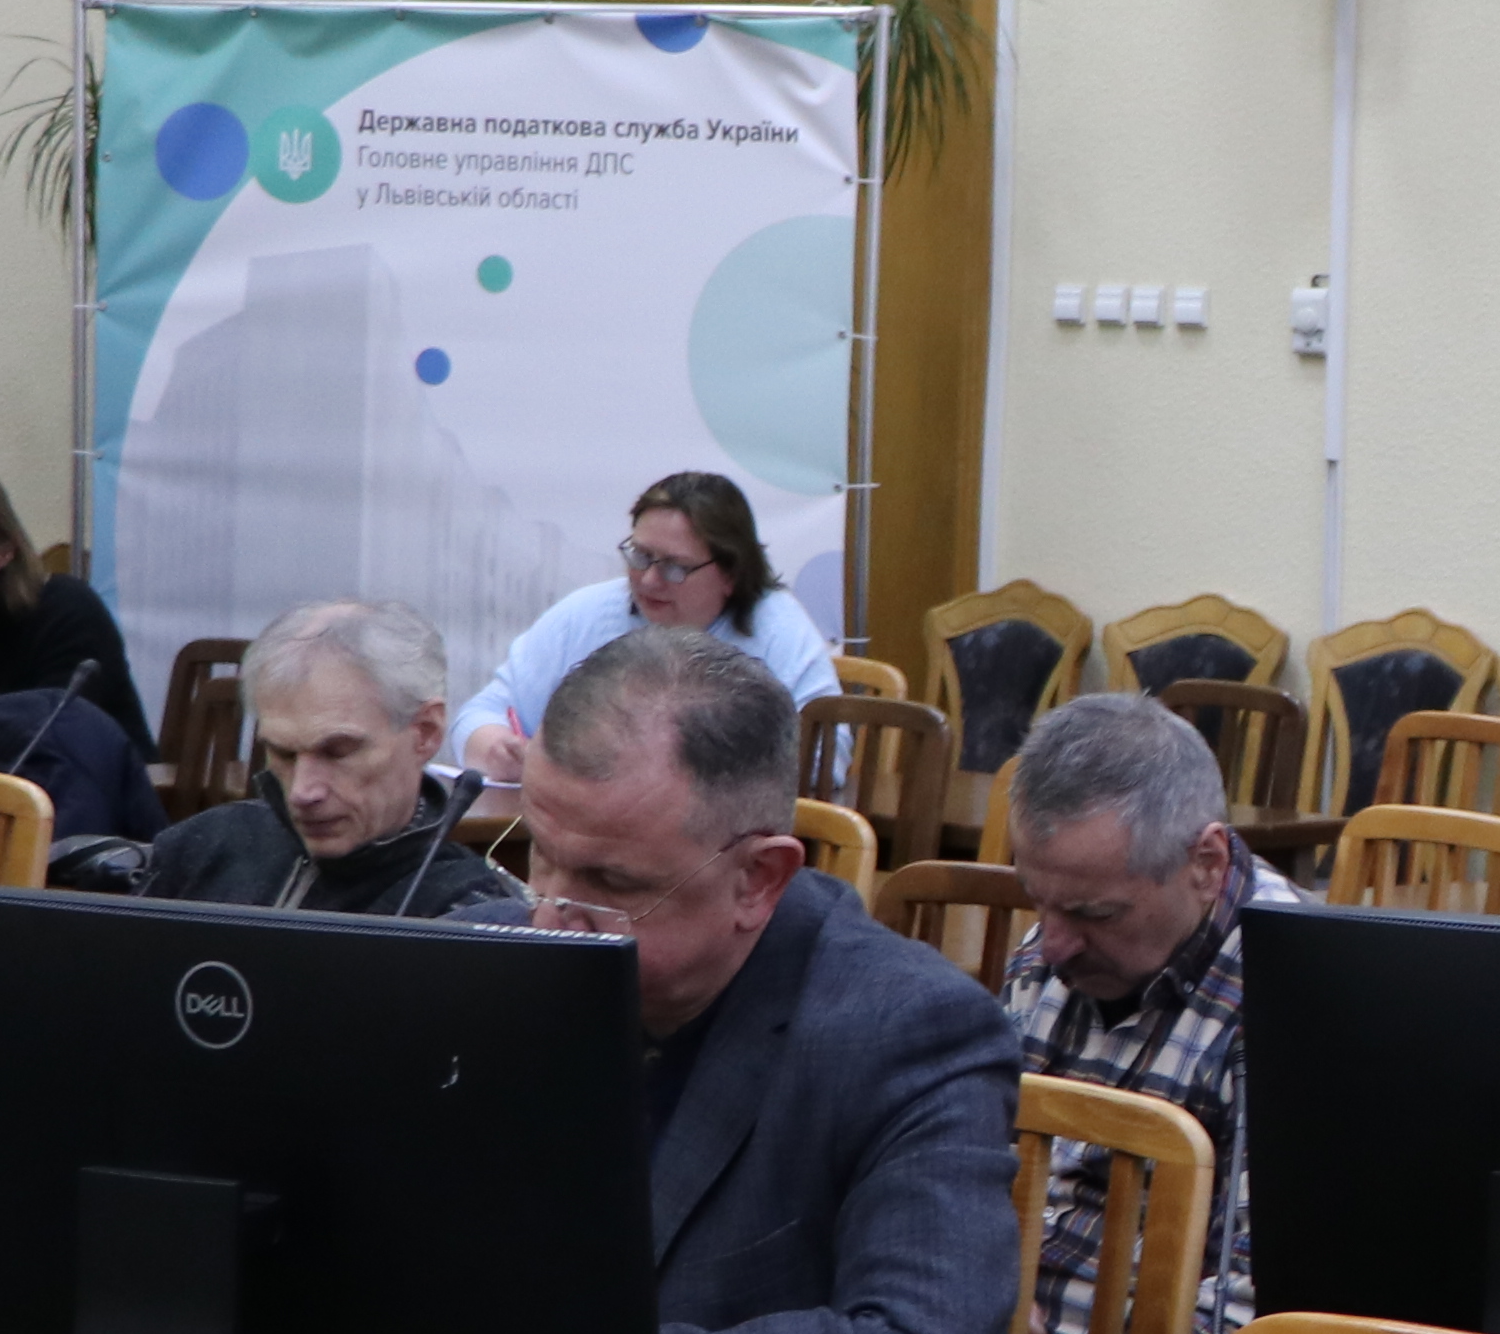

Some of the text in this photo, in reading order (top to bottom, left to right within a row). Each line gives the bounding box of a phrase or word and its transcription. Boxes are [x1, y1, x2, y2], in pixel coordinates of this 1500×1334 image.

[358, 109, 799, 146] Державна податкова служба України
[357, 145, 634, 176] Головне управління ДПС
[356, 182, 579, 210] у Львівській області
[185, 992, 245, 1018] DELL
